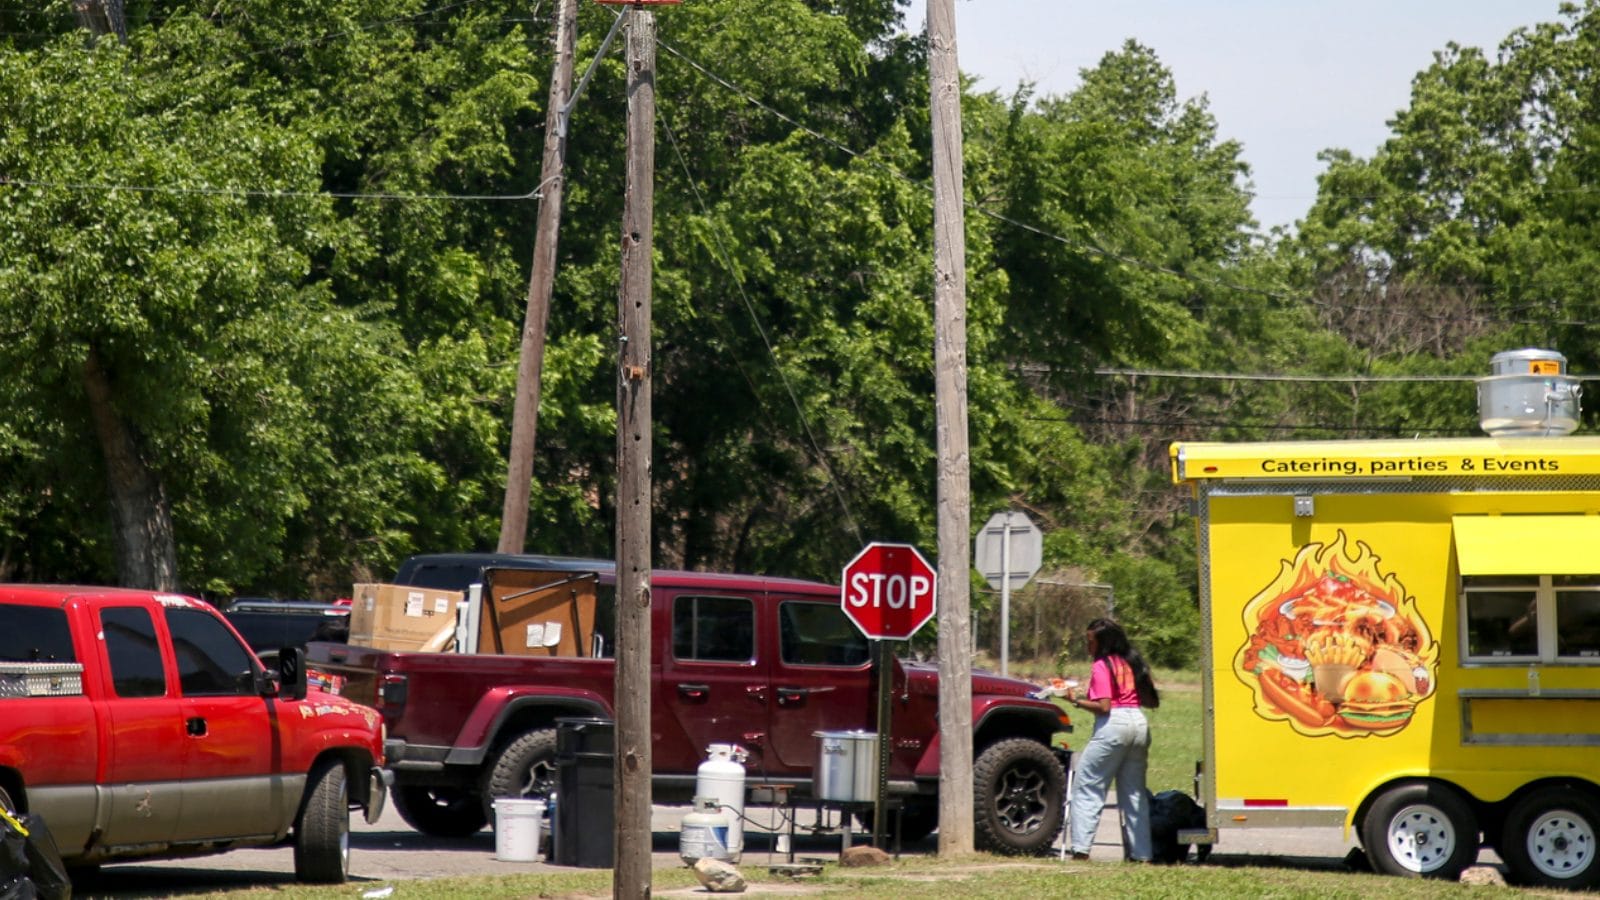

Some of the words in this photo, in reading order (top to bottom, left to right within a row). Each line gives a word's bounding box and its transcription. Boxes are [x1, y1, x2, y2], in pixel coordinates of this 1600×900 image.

[1261, 458, 1363, 474] Catering,
[1371, 457, 1448, 474] parties
[1461, 458, 1475, 471] &
[1484, 458, 1559, 471] Events
[849, 572, 929, 609] STOP
